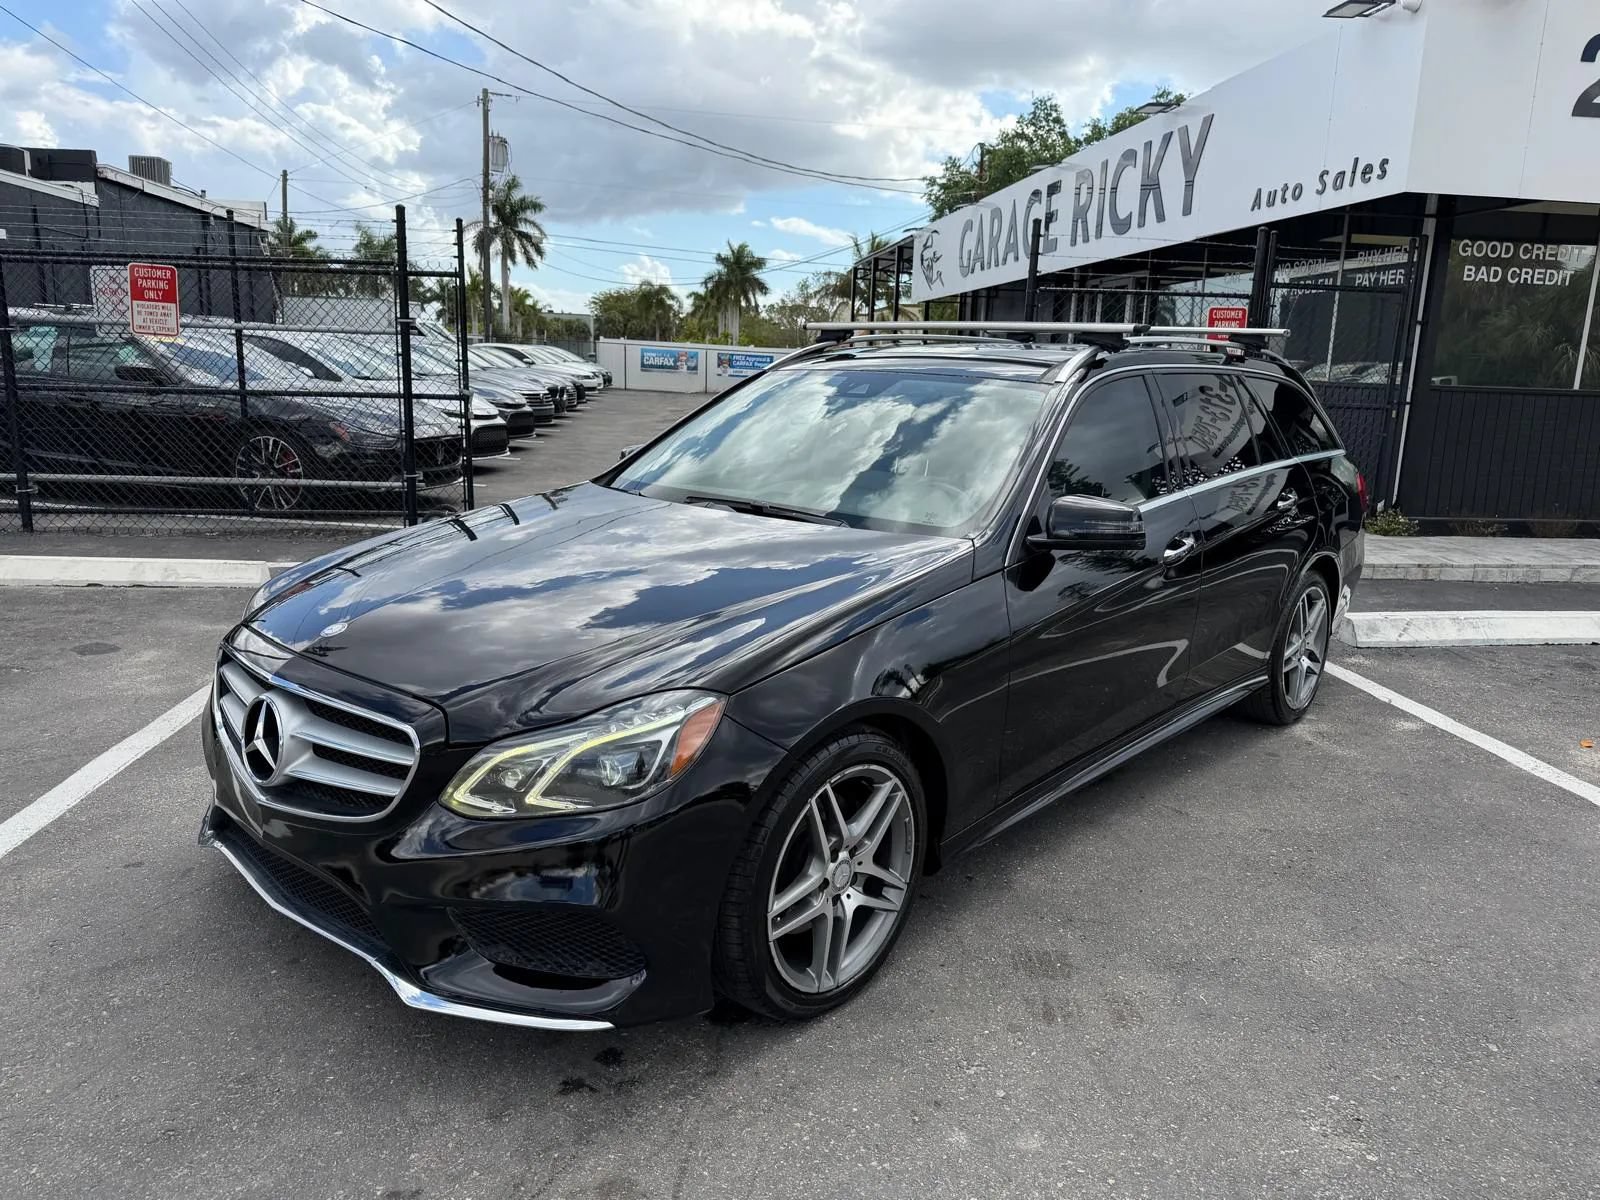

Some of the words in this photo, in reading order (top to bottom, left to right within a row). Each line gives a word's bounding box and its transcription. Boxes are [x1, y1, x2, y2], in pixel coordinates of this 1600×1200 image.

[1250, 182, 1303, 212] Auto
[1315, 156, 1390, 196] Sales
[958, 179, 1062, 278] GARAGE
[1069, 113, 1215, 247] RICKY
[1383, 245, 1411, 262] HER
[1458, 239, 1514, 258] GOOD
[1519, 243, 1586, 263] CREDIT
[134, 267, 172, 279] CUSTOMER
[1355, 271, 1378, 288] PAY
[1378, 268, 1411, 287] HER
[1463, 265, 1502, 282] BAD
[1507, 267, 1576, 286] CREDIT
[137, 278, 169, 290] PARKING
[143, 290, 163, 300] ONLY
[1212, 309, 1243, 319] CUSTOMER
[1213, 319, 1240, 328] PARKING
[643, 356, 674, 366] CARFAX
